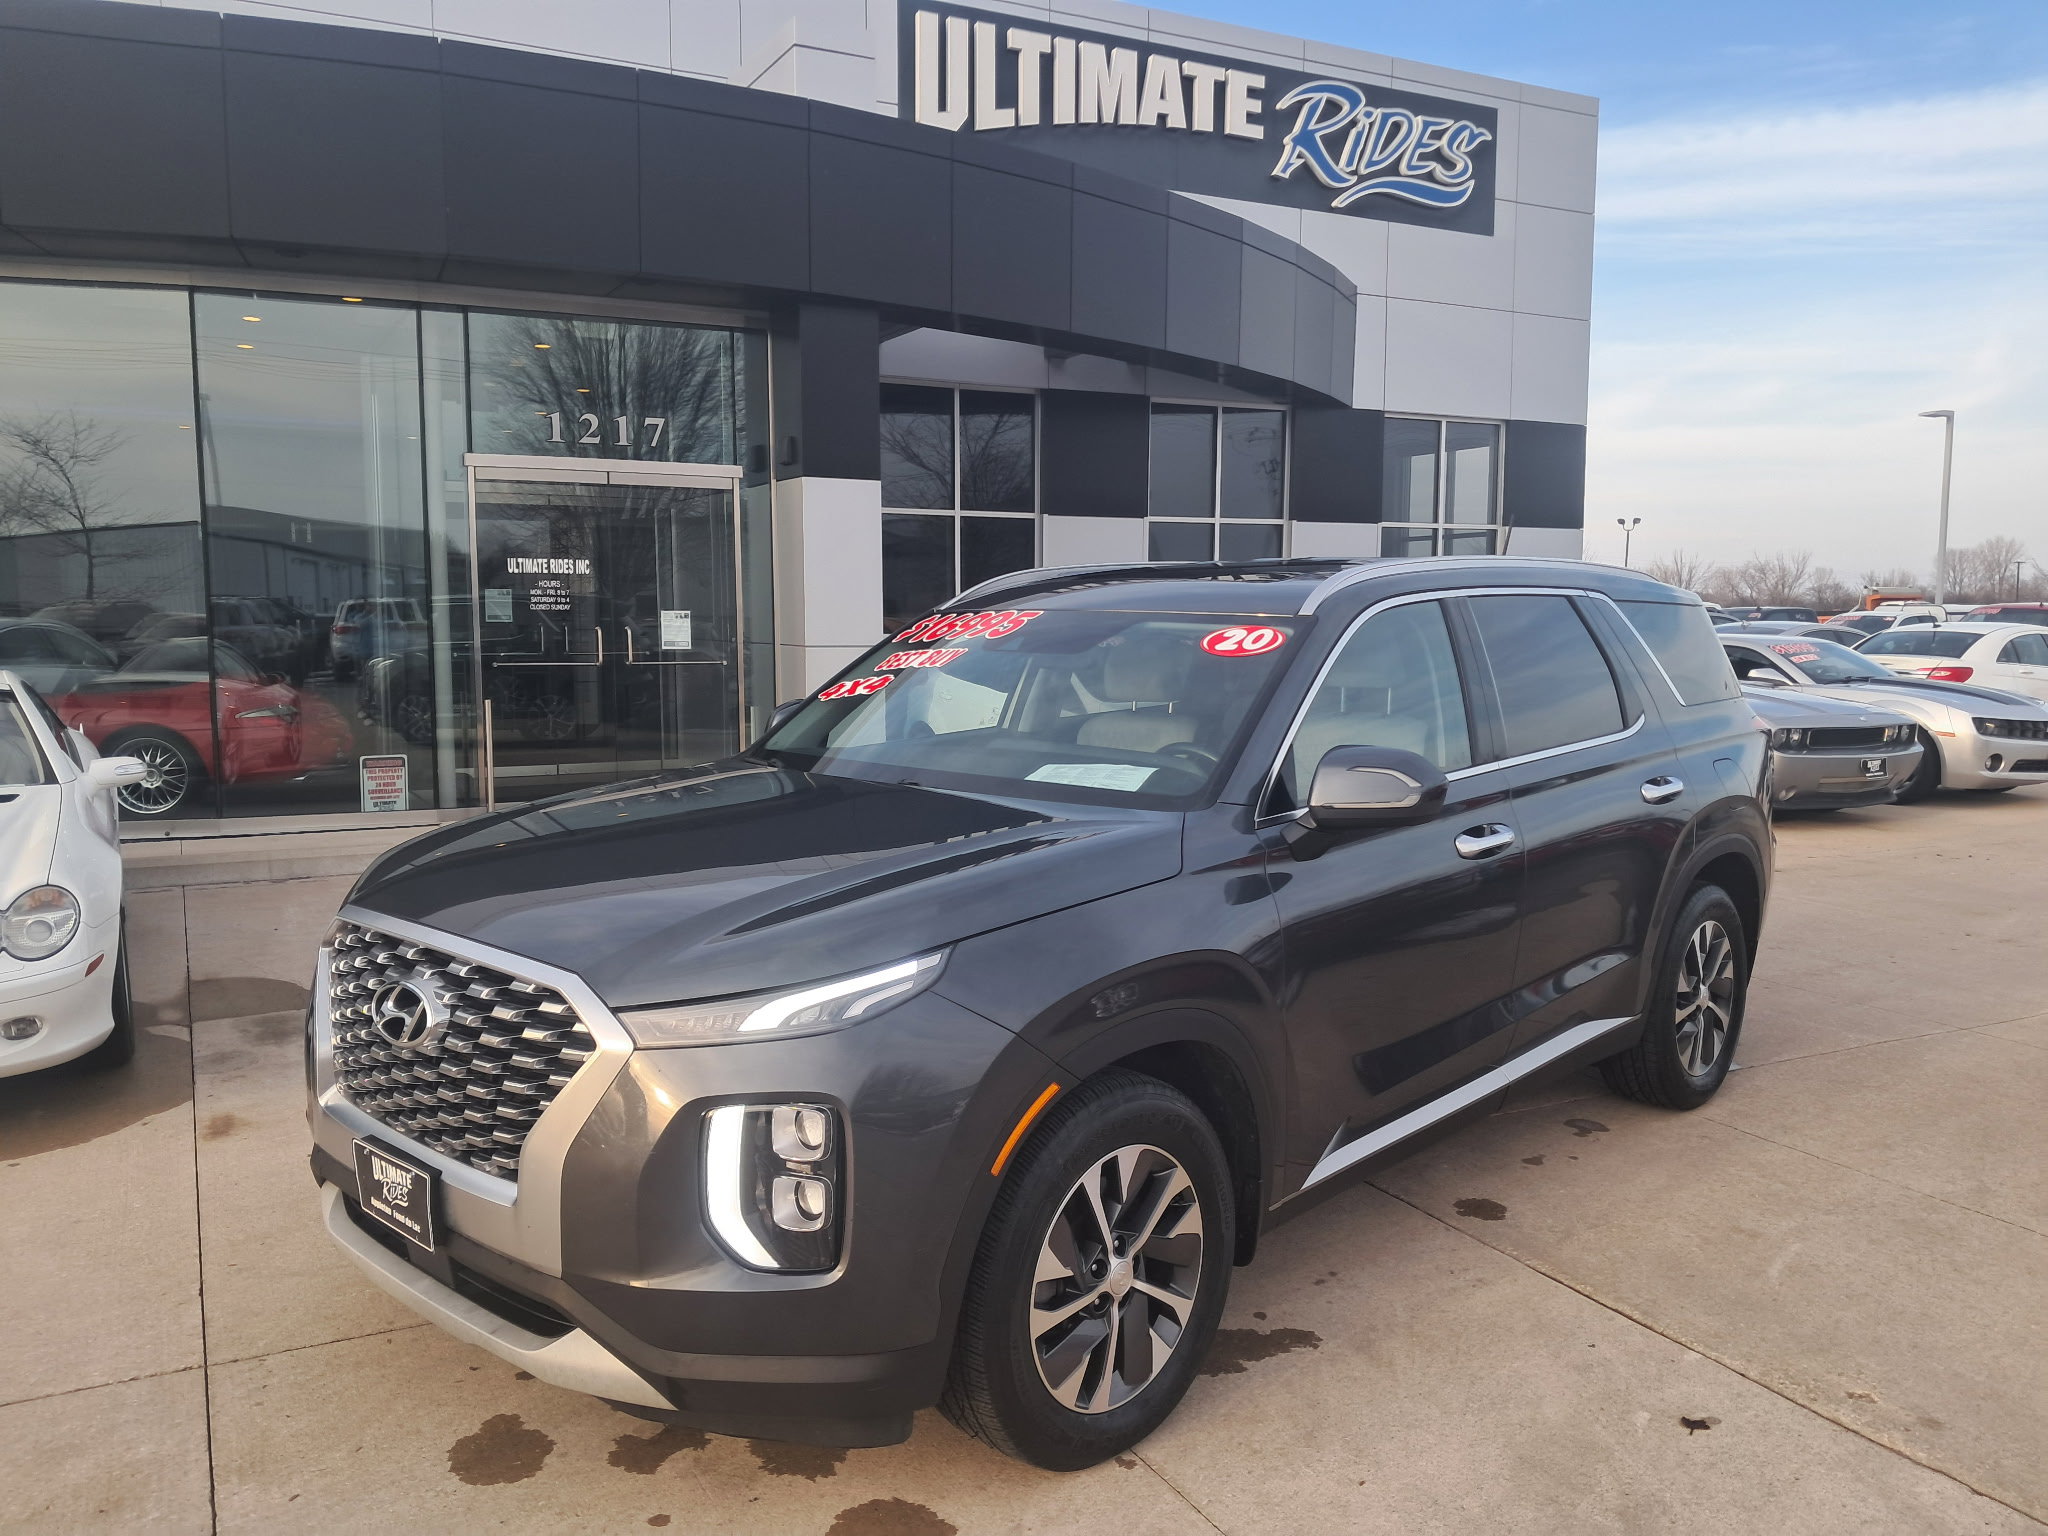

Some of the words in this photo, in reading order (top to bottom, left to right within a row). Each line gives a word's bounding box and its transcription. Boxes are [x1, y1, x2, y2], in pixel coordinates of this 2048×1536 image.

[915, 10, 1266, 140] ULTIMATE
[545, 412, 665, 447] 1217
[507, 558, 548, 574] ULTIMATE
[550, 559, 574, 574] RIDES
[576, 560, 590, 574] INC
[1214, 629, 1275, 650] 20
[874, 649, 929, 671] BEST
[917, 648, 968, 668] BUY
[371, 1155, 413, 1190] ULTIMATE
